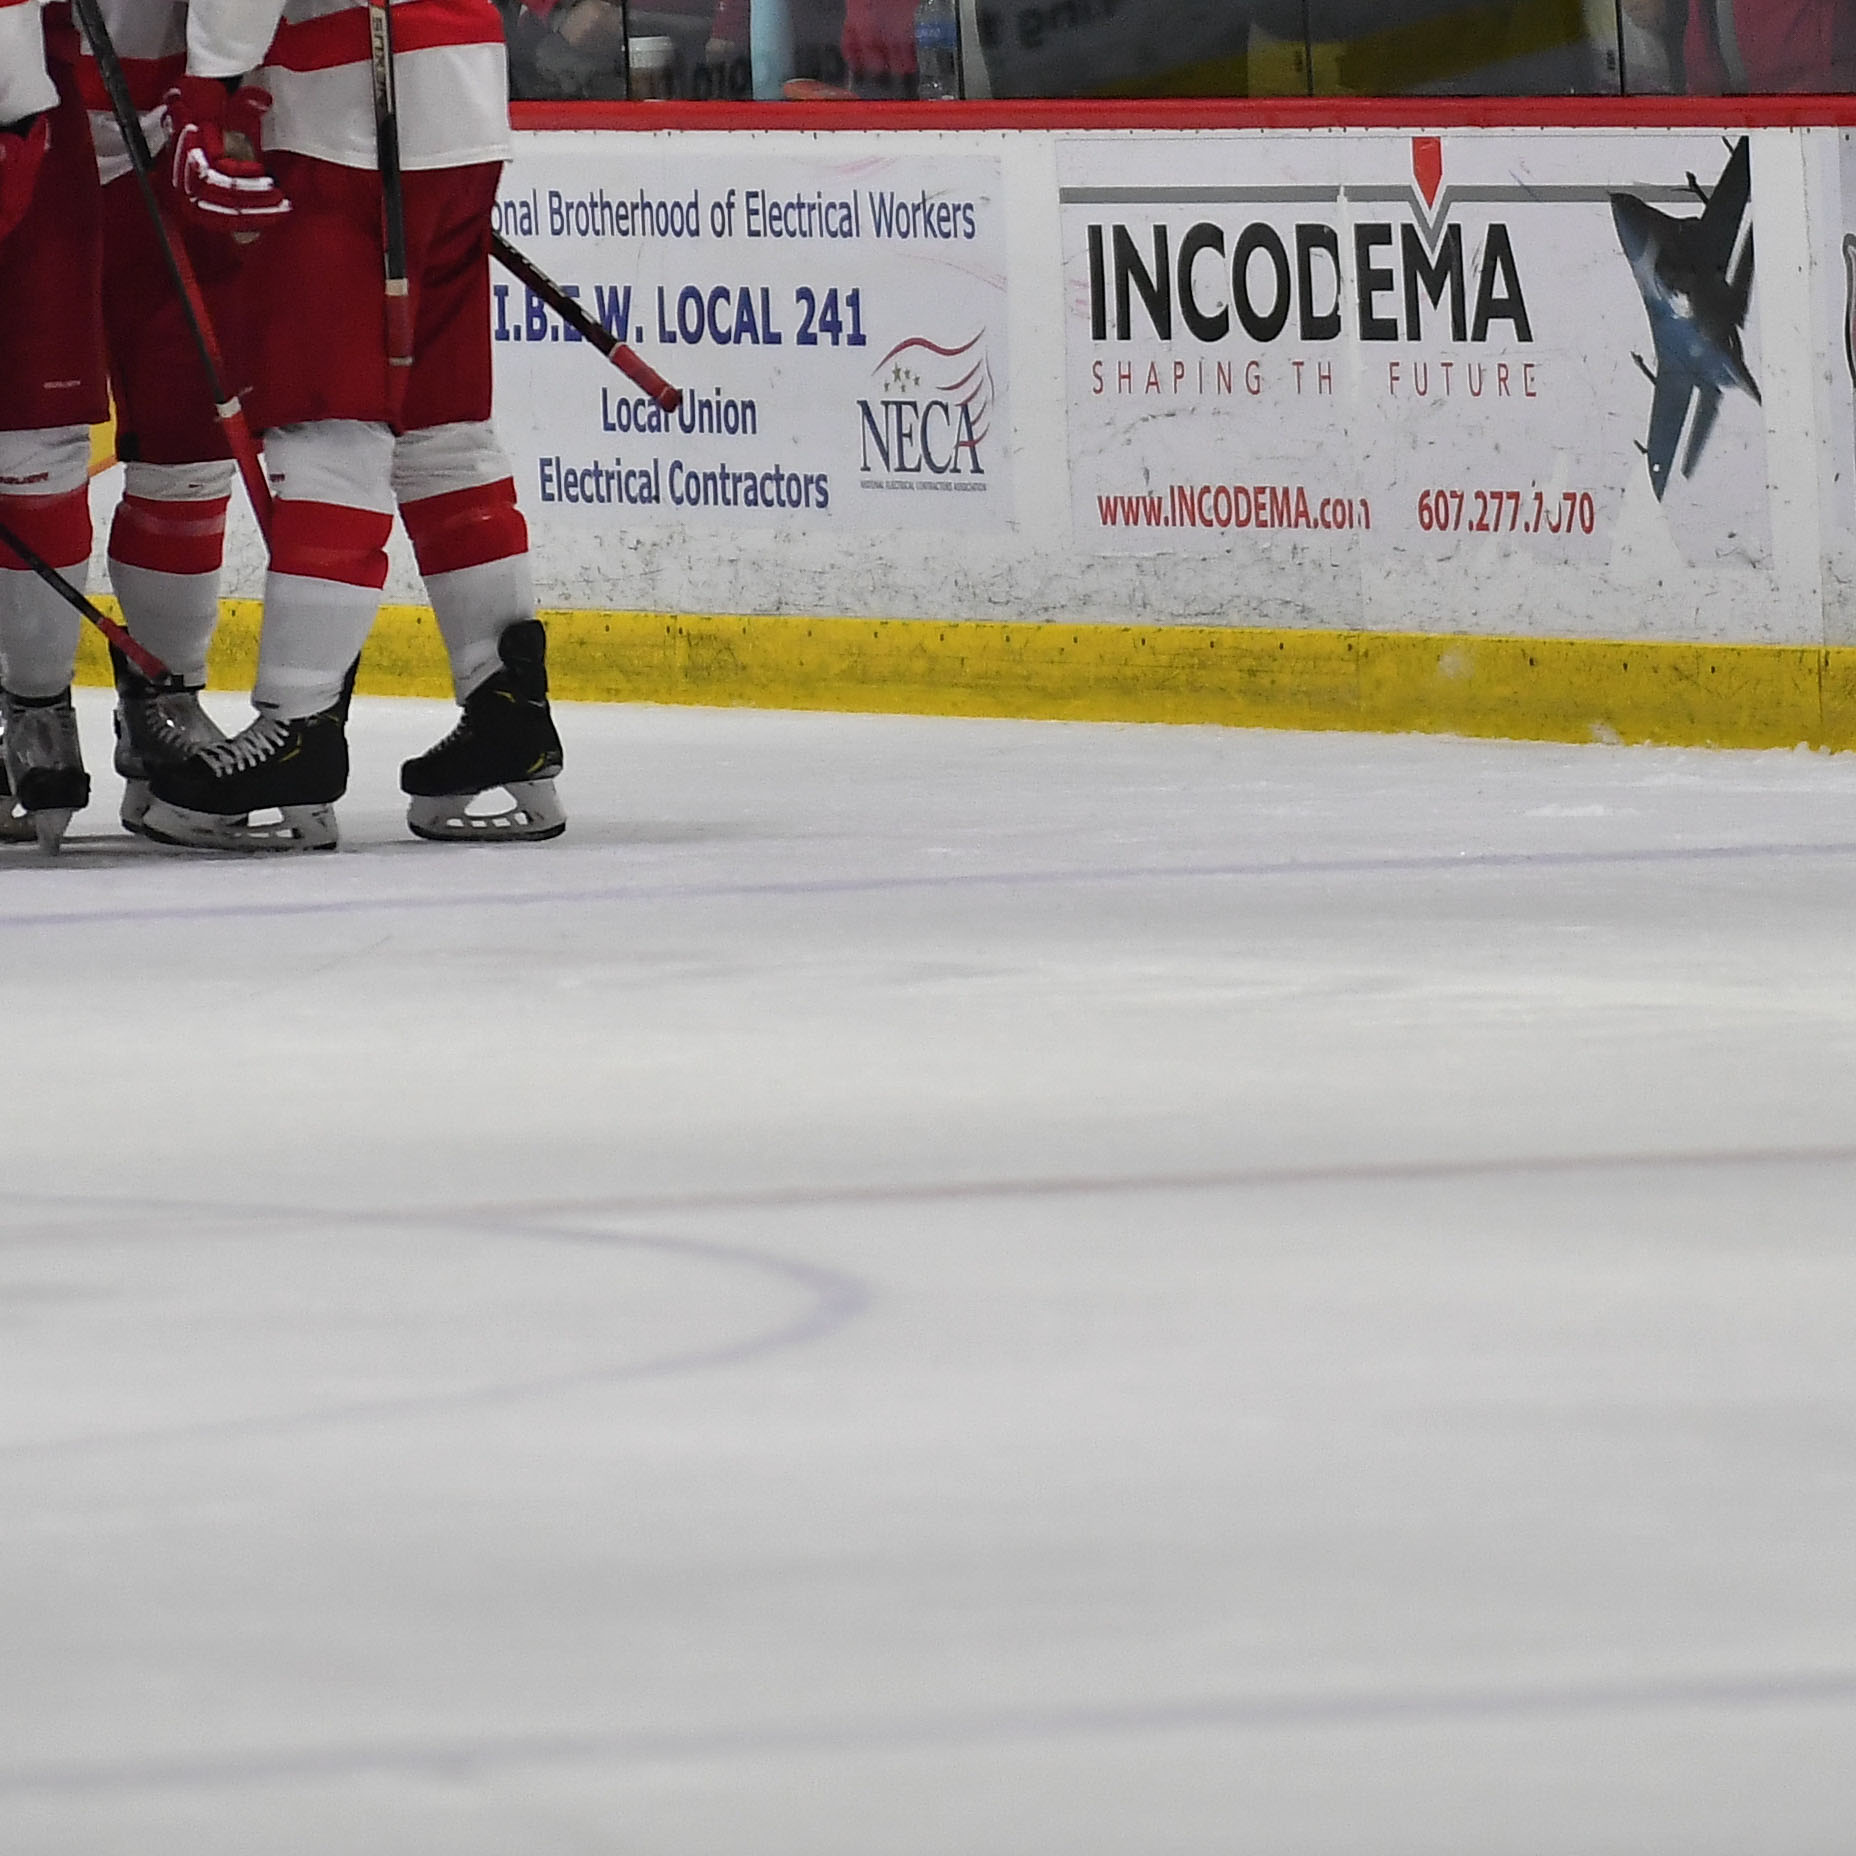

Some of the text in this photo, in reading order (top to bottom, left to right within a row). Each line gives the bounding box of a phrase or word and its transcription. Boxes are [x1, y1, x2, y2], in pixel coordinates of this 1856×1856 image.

[549, 190, 700, 237] Brotherhood
[710, 189, 737, 237] of
[746, 191, 860, 238] Electrical
[868, 191, 977, 240] Workers
[1087, 222, 1534, 344] INCODEMA
[658, 286, 782, 345] LOCAL
[795, 287, 867, 346] 241
[1091, 359, 1263, 397] SHAPING
[1389, 360, 1539, 399] FUTURE
[678, 387, 757, 435] Union
[856, 398, 985, 475] NECA
[539, 456, 829, 509] Electrical Contractors
